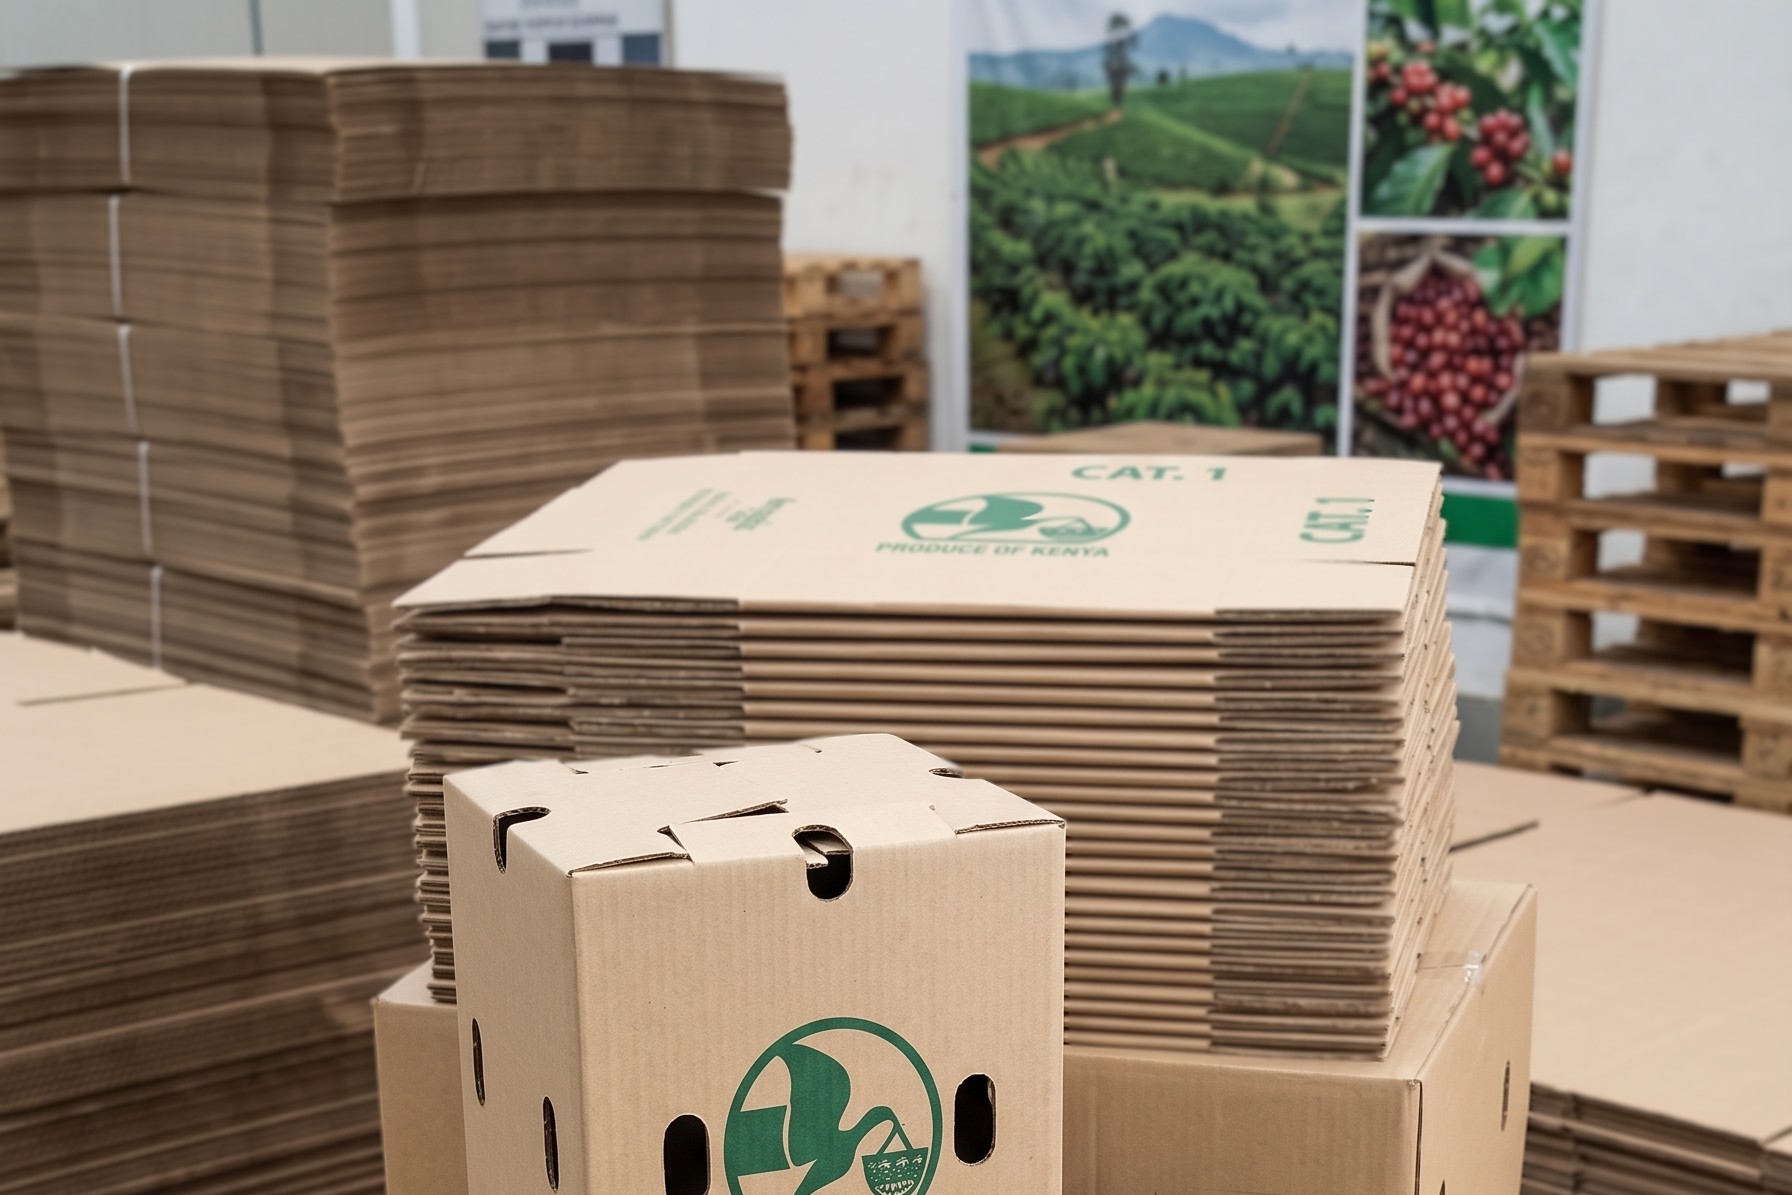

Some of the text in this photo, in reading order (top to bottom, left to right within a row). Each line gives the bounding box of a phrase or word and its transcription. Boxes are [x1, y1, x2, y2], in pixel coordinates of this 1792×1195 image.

[1071, 465, 1227, 481] CAT. 1
[1299, 508, 1372, 543] CAT.
[875, 541, 1109, 557] PRODUCE OF KENYA
